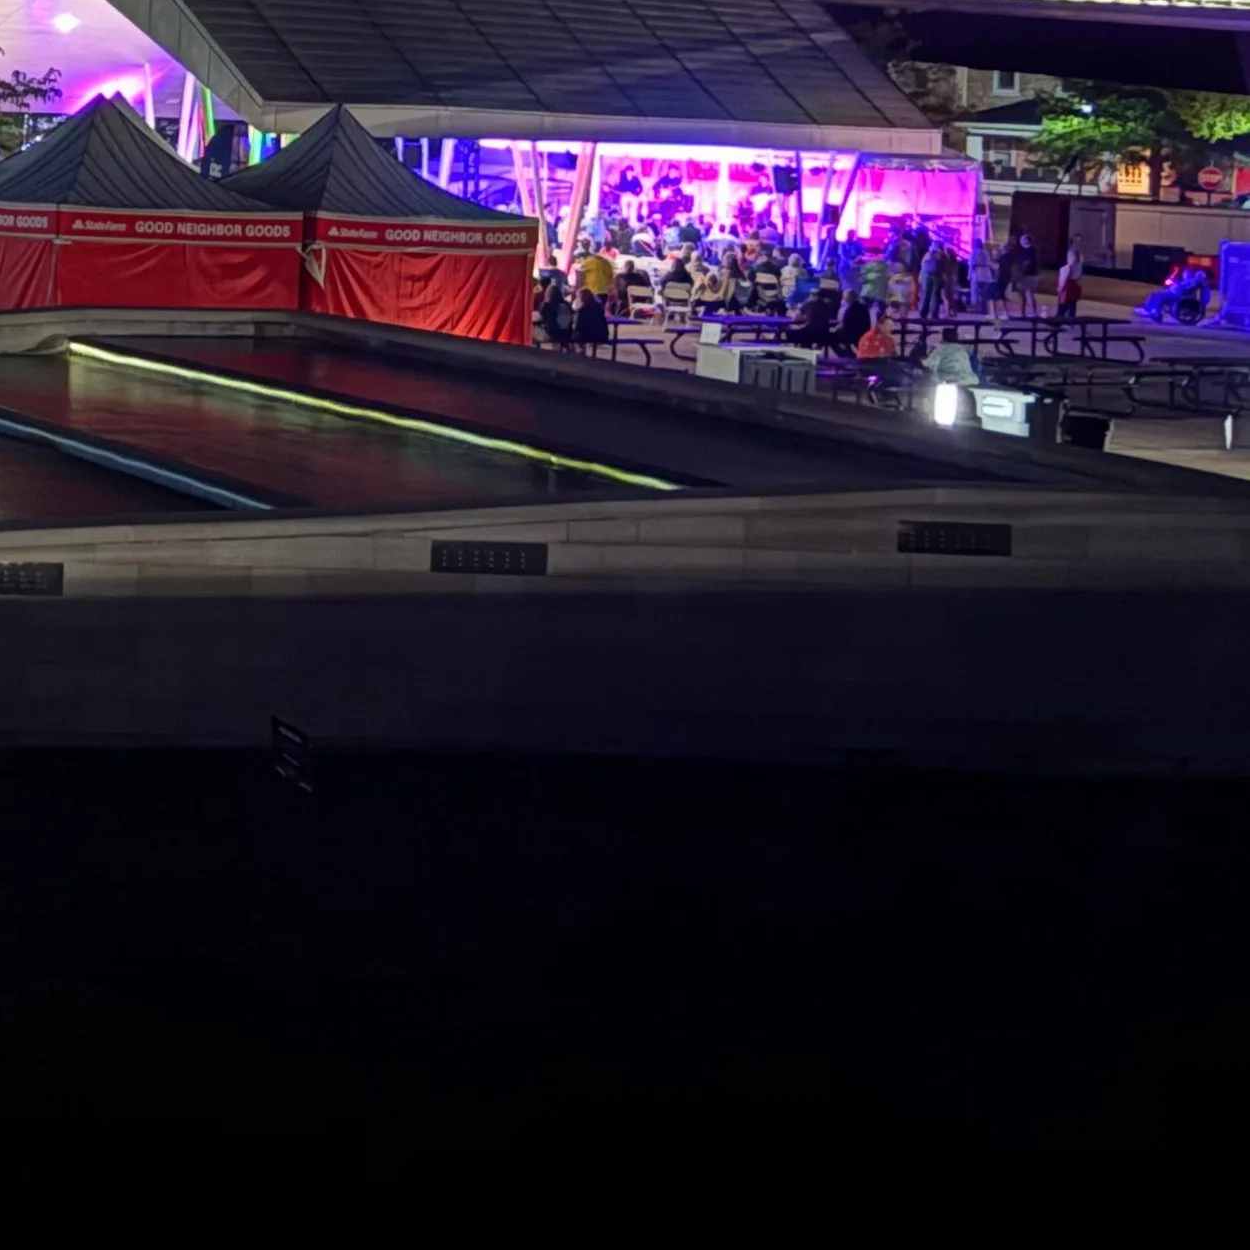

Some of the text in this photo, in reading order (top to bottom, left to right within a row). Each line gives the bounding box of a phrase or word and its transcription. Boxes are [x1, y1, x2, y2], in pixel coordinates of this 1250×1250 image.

[16, 215, 48, 229] GOODS
[134, 220, 174, 234] GOOD
[176, 222, 243, 237] NEIGHBOR
[245, 224, 291, 238] GOODS
[385, 229, 420, 242] GOOD
[423, 230, 483, 243] NEIGHBOR
[485, 231, 528, 244] GOODS
